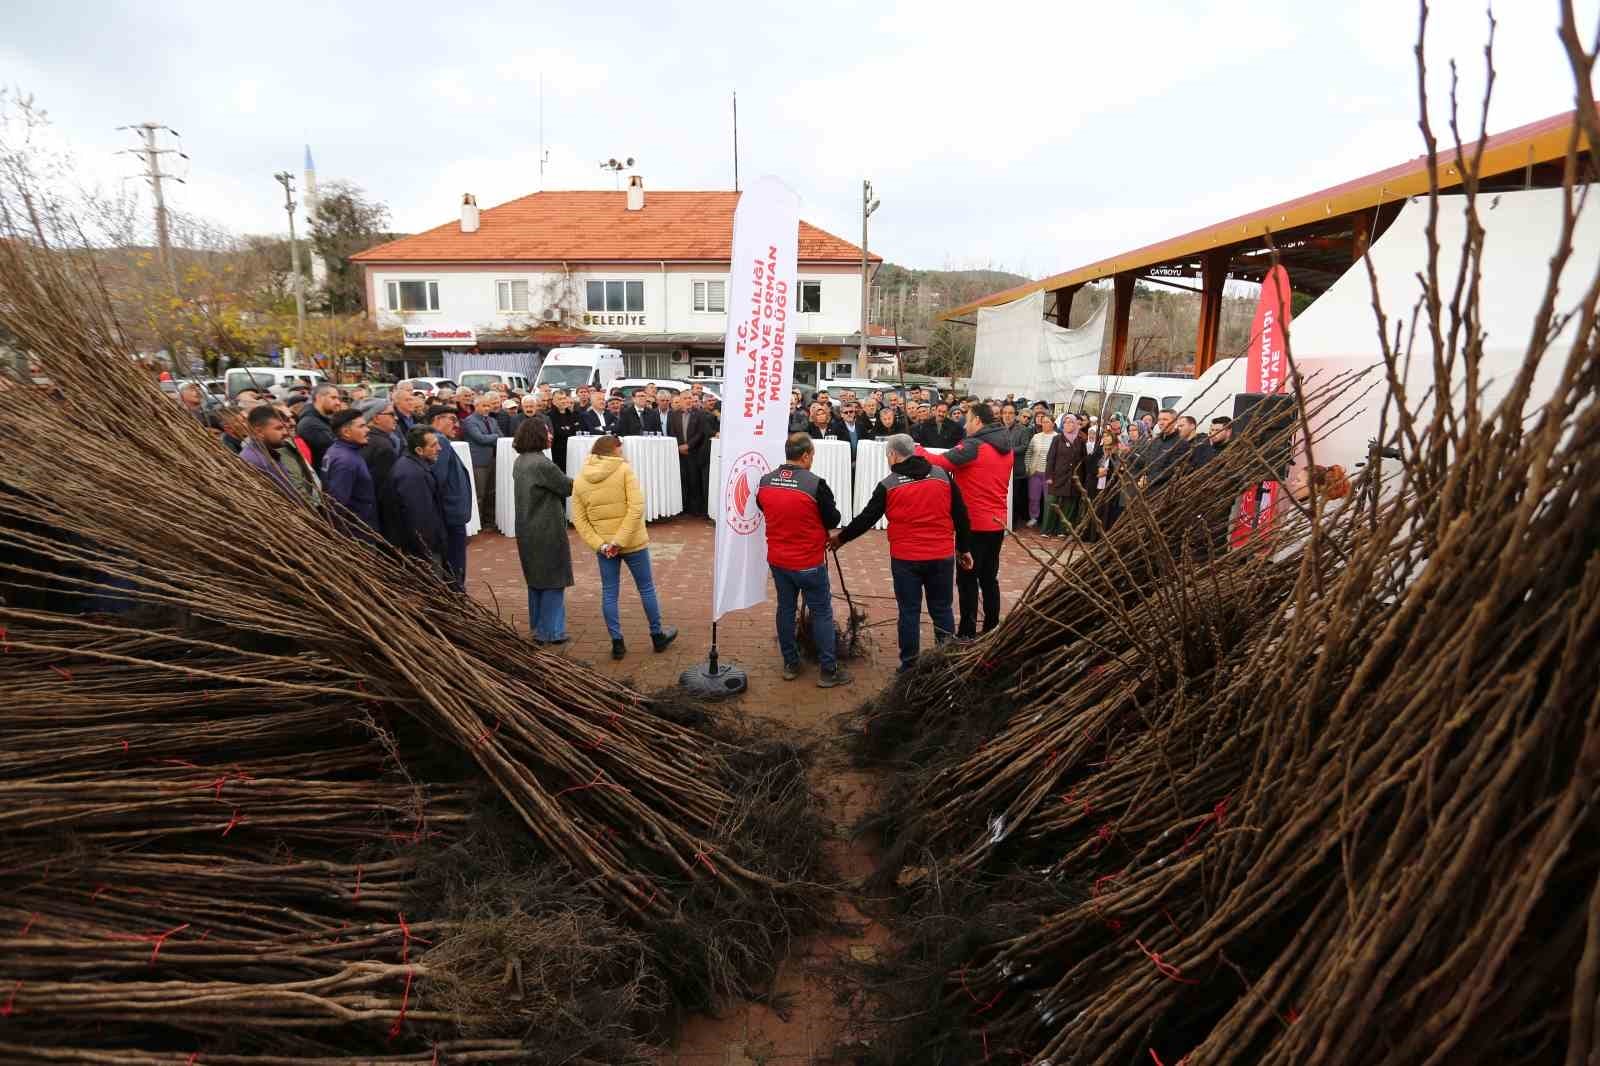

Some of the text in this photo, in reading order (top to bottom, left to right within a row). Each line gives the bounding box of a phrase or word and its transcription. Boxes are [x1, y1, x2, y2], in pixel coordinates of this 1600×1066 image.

[583, 313, 647, 326] BELEDİYE
[736, 320, 748, 354] T.C.
[743, 258, 765, 419] MUĞLA VALİLİĞİ
[753, 246, 778, 436] İL TARIM VE ORMAN
[770, 280, 788, 402] MÜDÜRLÜĞÜ
